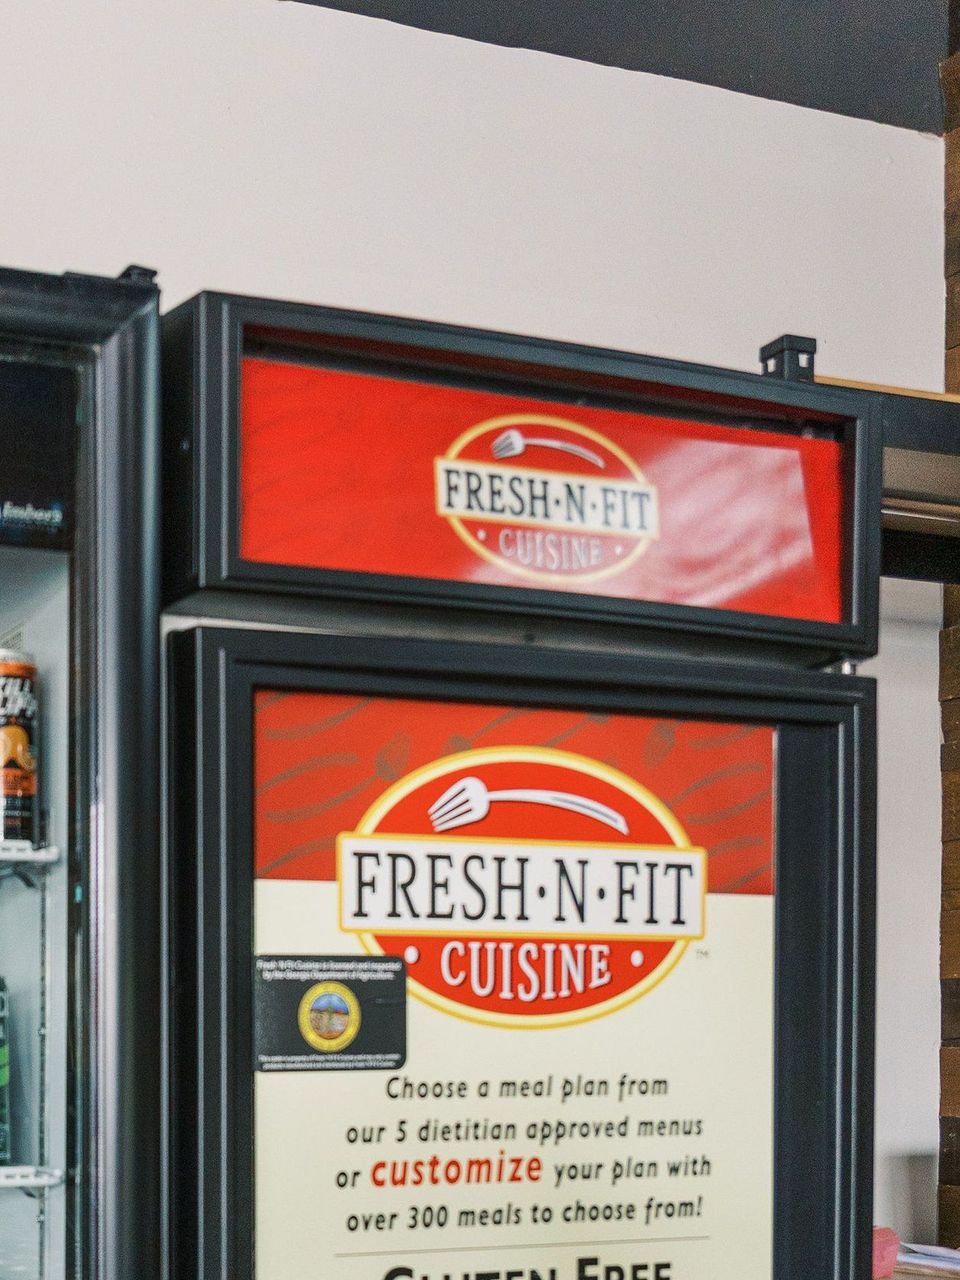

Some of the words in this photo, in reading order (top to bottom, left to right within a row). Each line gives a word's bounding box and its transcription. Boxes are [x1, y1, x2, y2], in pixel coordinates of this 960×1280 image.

[498, 528, 603, 570] CUISINE
[441, 941, 612, 1003] CUISINE
[385, 1077, 467, 1100] Choose
[478, 1082, 488, 1098] a
[499, 1076, 552, 1098] meal
[561, 1075, 609, 1103] plan
[619, 1074, 669, 1101] from
[347, 1121, 386, 1144] our
[396, 1120, 407, 1141] 5
[419, 1119, 516, 1142] dietitian
[526, 1116, 628, 1146] approved
[640, 1117, 703, 1138] menus
[336, 1169, 360, 1188] or
[371, 1151, 542, 1187] customize
[554, 1161, 602, 1188] your
[612, 1158, 658, 1187] plan
[667, 1155, 711, 1177] with
[347, 1210, 398, 1232] over
[408, 1207, 448, 1229] 300
[458, 1204, 521, 1228] meals
[530, 1203, 552, 1223] to
[561, 1199, 636, 1222] choose
[644, 1195, 703, 1226] from!
